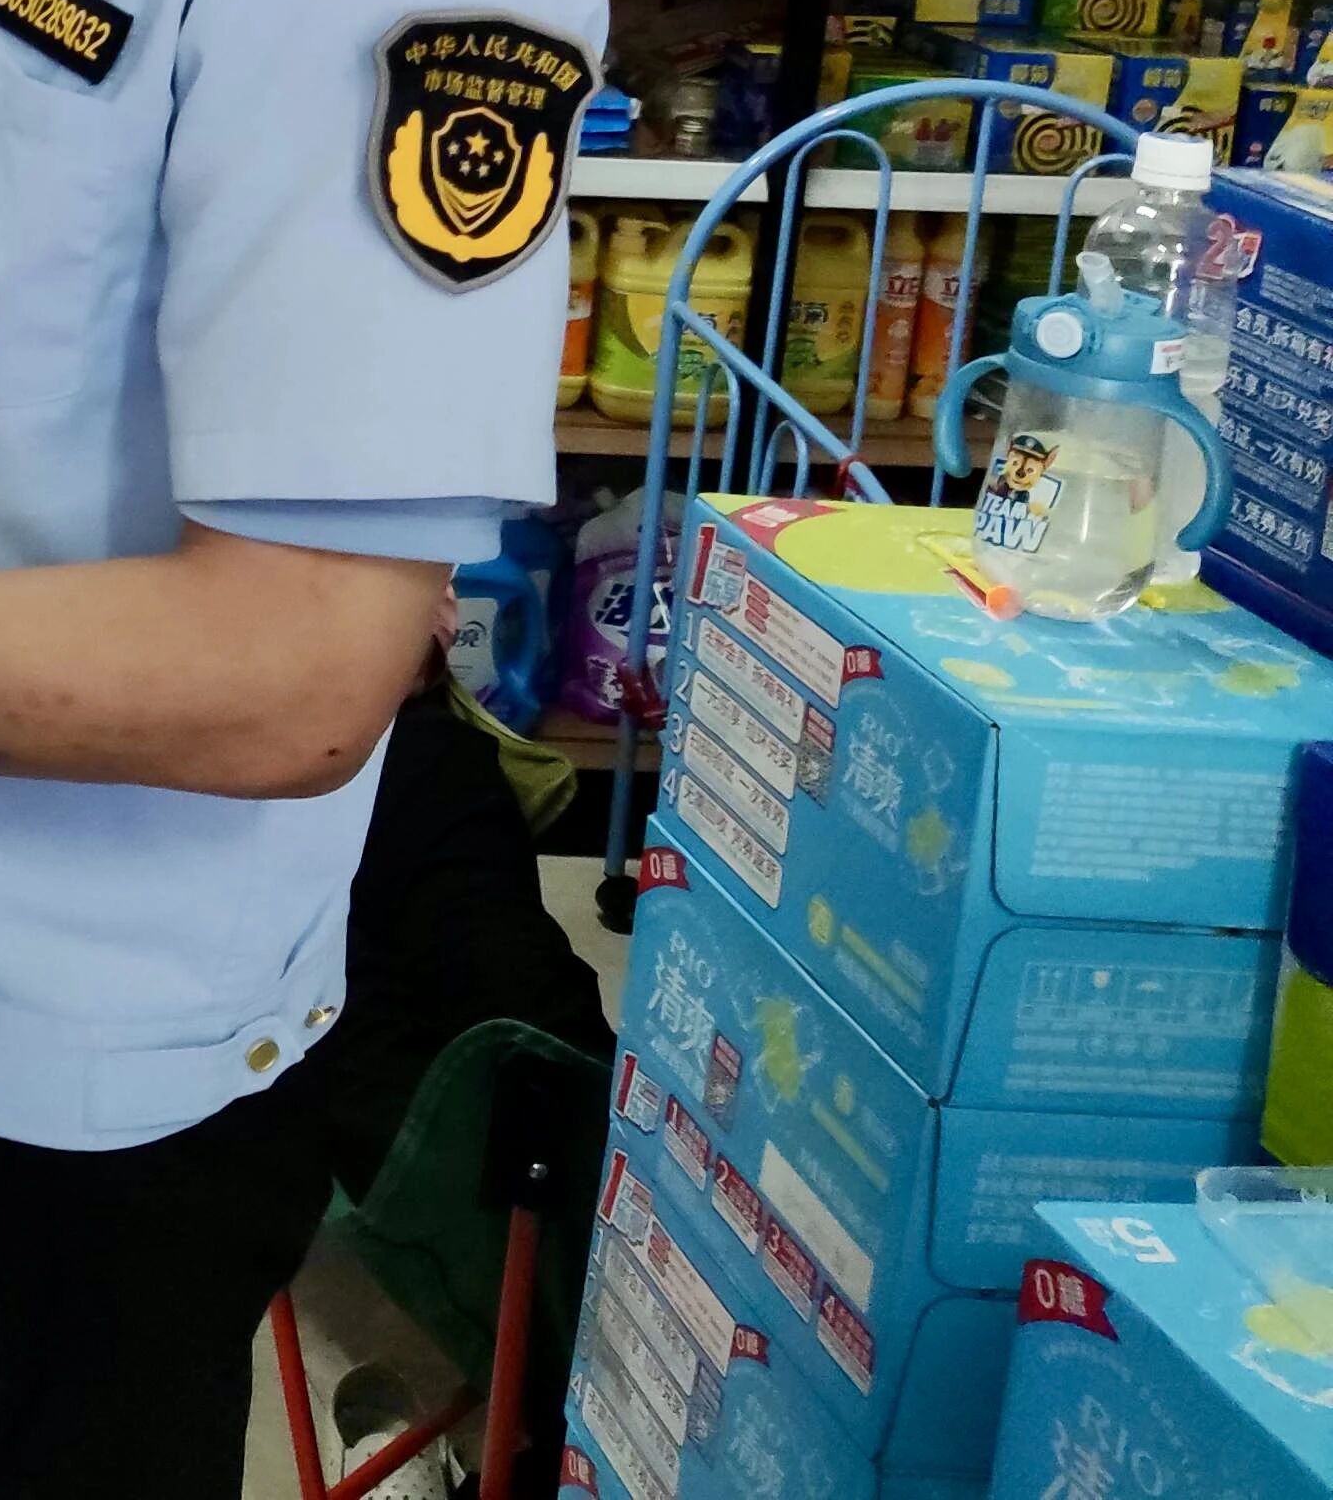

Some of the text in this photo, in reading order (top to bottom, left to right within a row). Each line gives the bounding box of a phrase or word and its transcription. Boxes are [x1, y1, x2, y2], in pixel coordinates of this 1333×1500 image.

[404, 32, 583, 93] 中华人民共和国
[423, 68, 548, 111] 市场监督管理
[982, 491, 1029, 519] TEAM
[974, 511, 1050, 553] PAW
